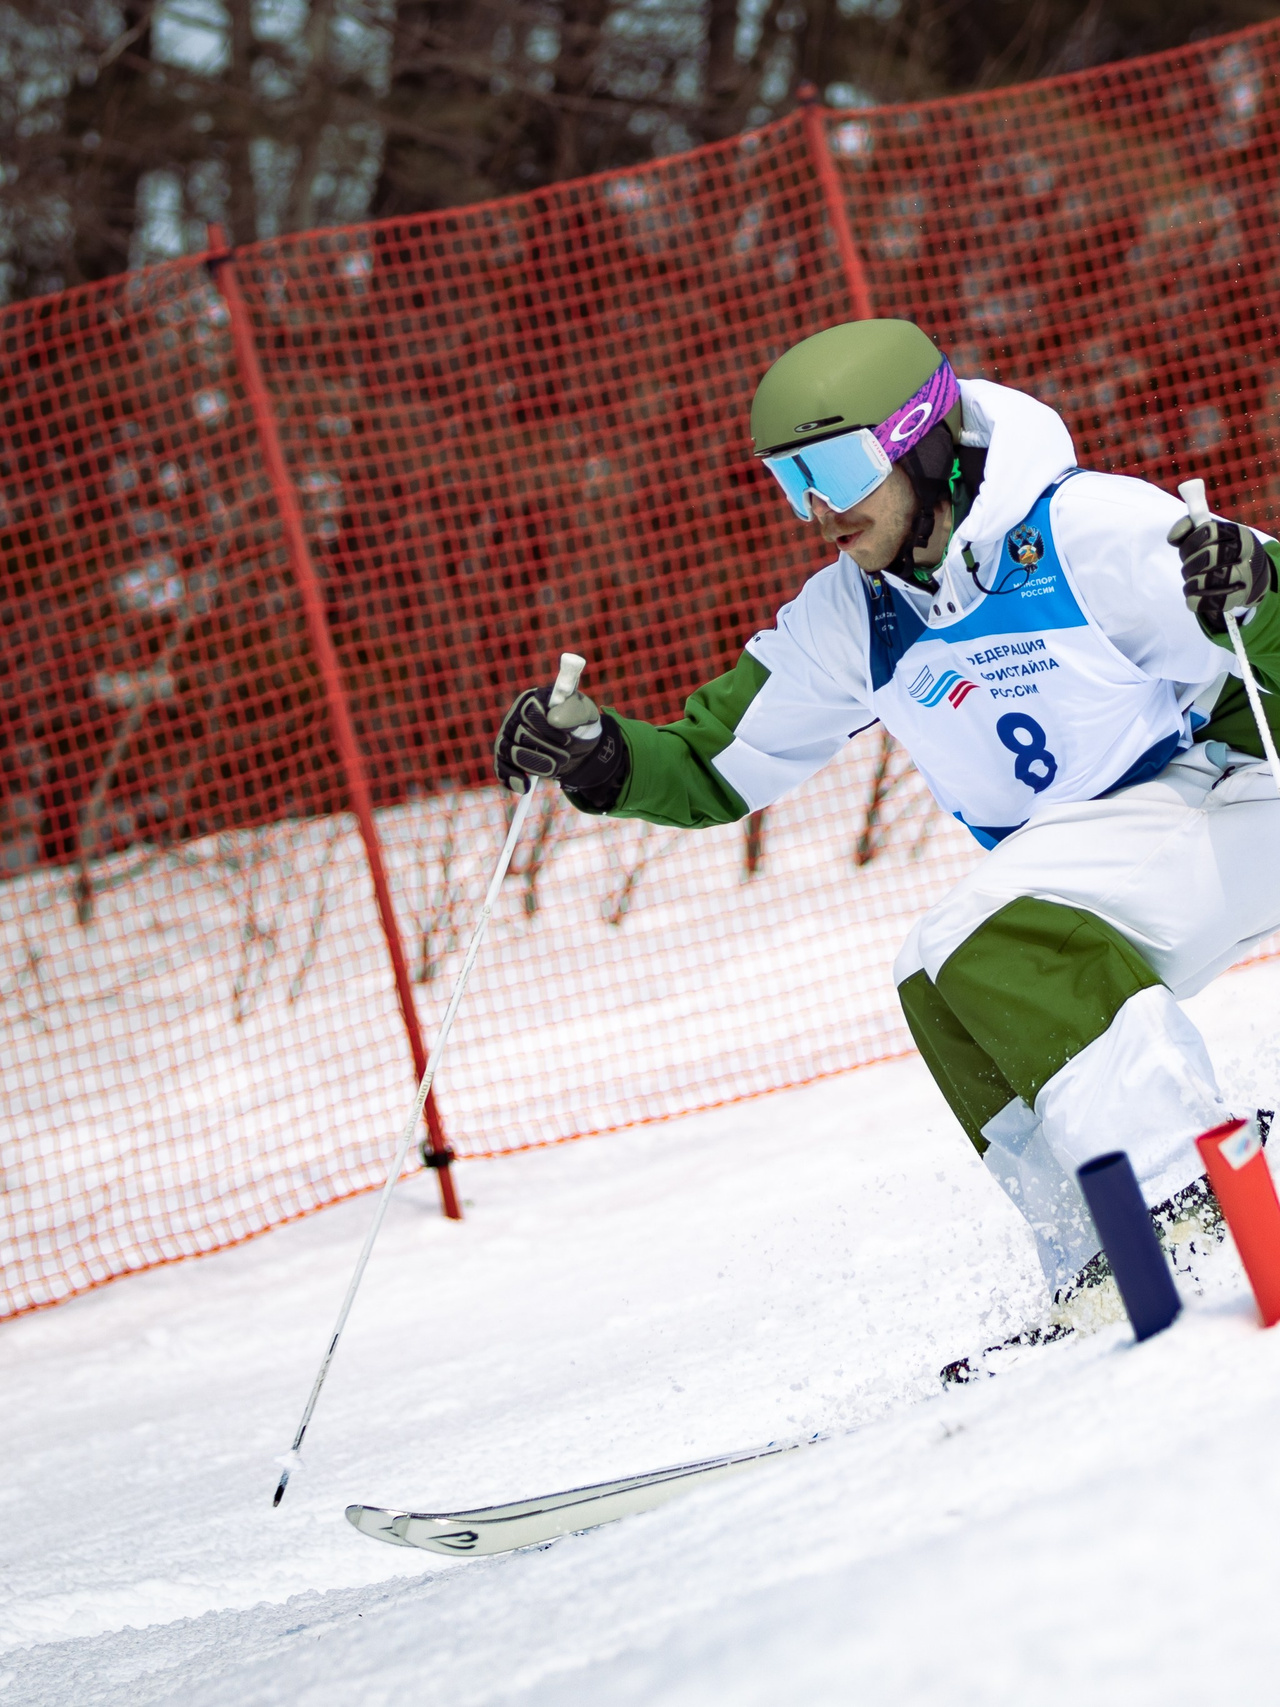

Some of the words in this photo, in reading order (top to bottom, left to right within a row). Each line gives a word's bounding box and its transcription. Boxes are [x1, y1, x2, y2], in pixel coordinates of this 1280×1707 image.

[1013, 575, 1057, 589] МНСПОРТ
[1020, 586, 1055, 598] РОССИИ
[996, 712, 1058, 794] 8
